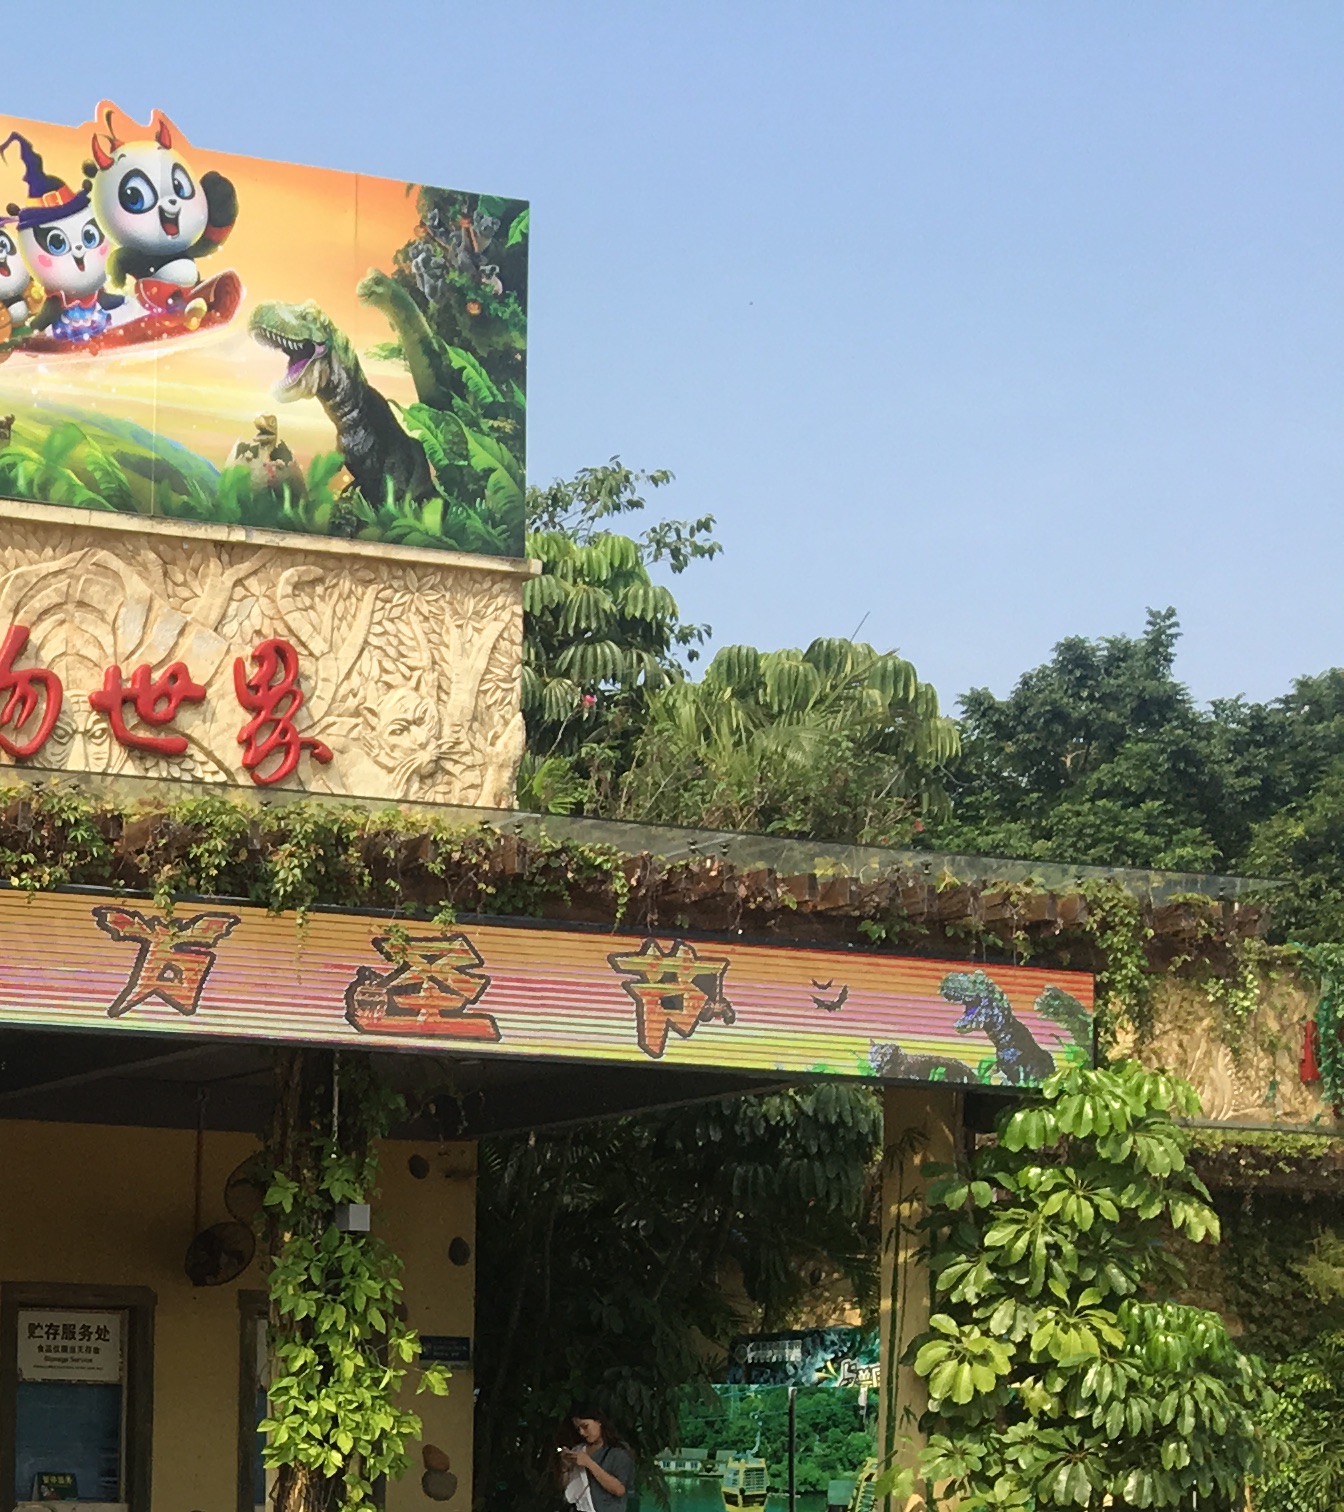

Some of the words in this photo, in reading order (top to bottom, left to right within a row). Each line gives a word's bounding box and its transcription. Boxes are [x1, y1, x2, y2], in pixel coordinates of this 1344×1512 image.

[27, 1322, 111, 1342] 贮存服务处
